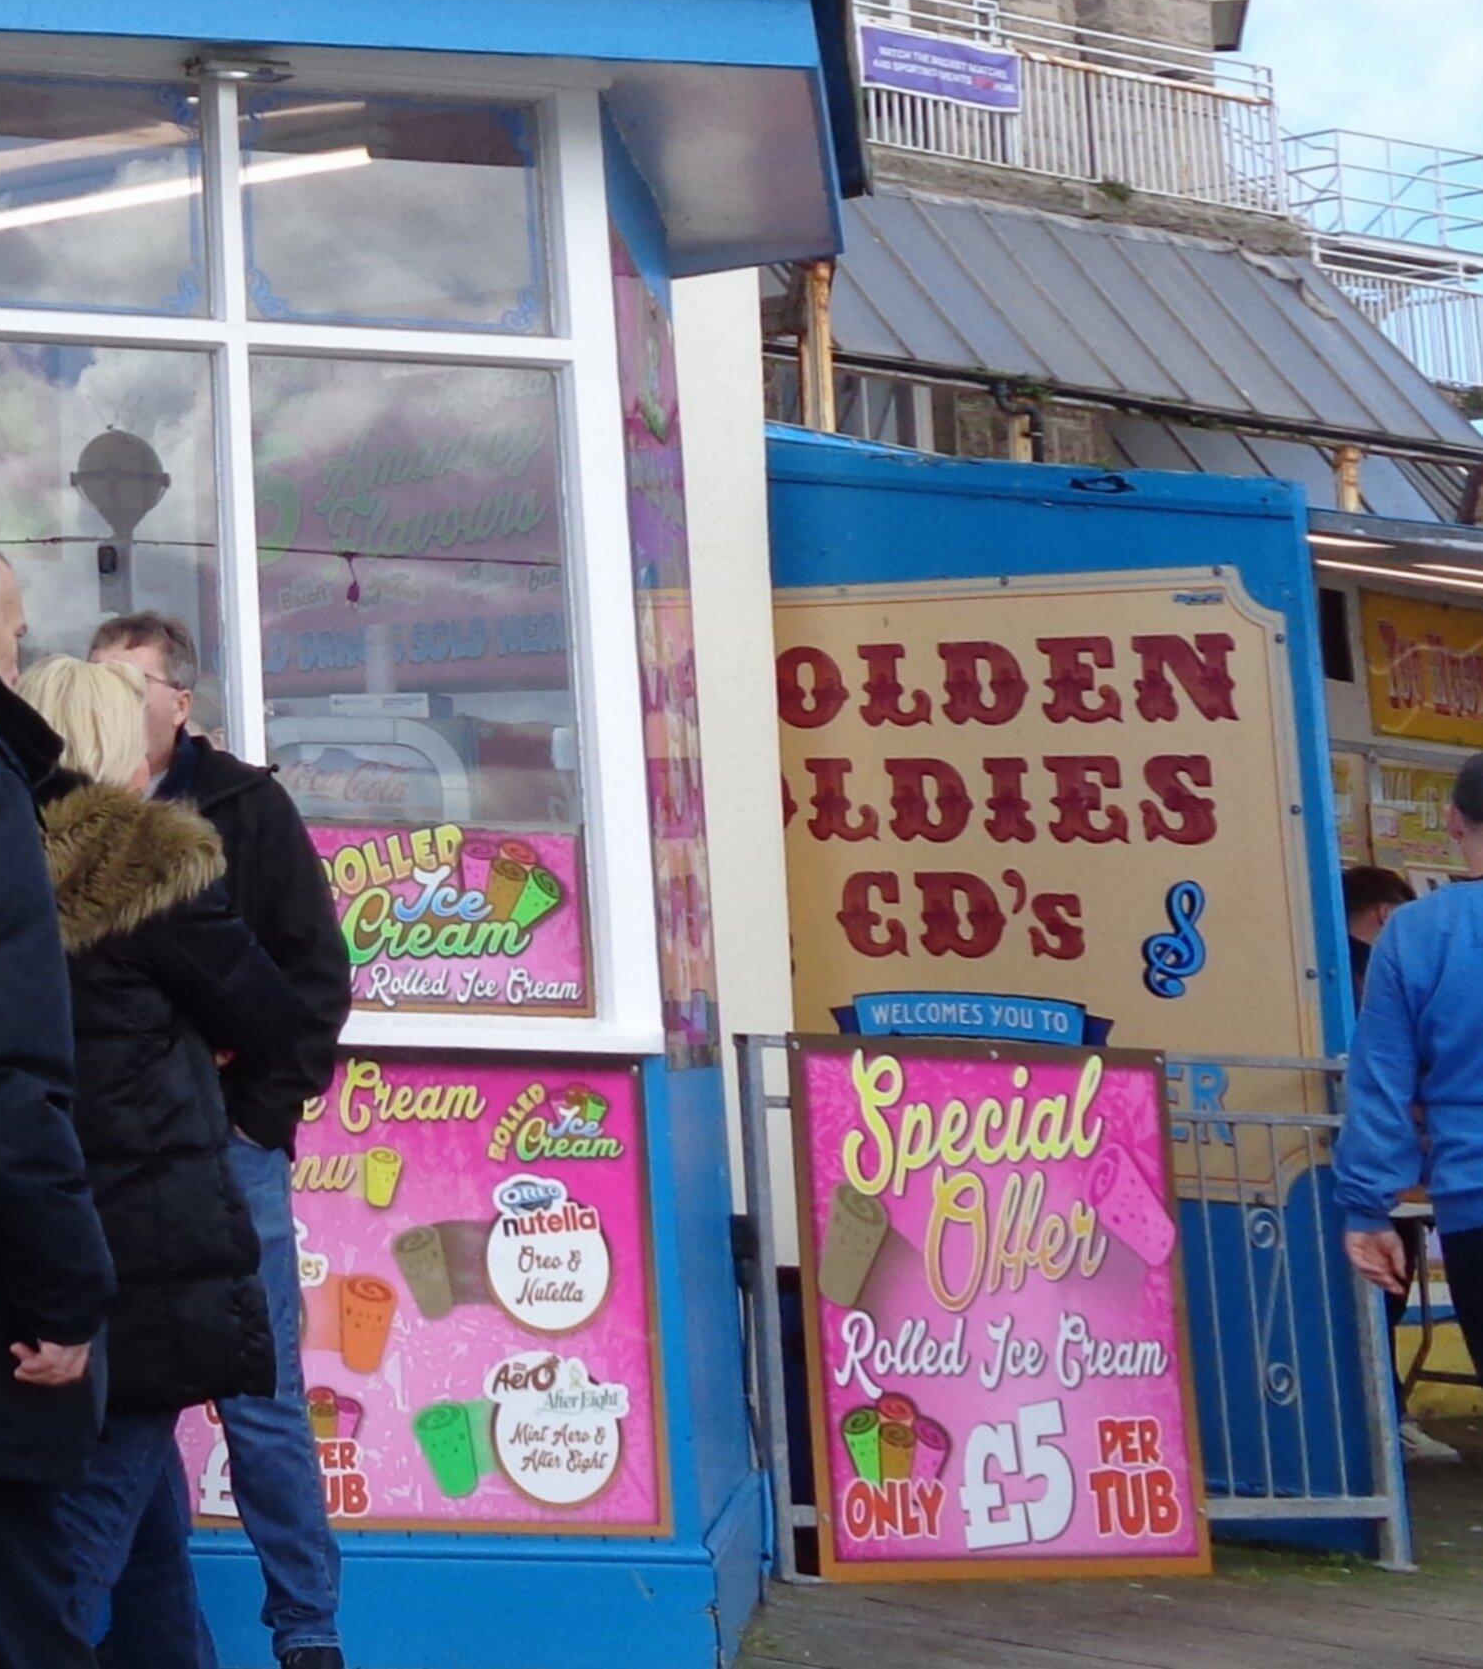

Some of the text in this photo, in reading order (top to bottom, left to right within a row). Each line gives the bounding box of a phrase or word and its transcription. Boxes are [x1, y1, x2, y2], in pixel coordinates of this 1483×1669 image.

[776, 634, 1240, 729] OLDEN
[782, 755, 1217, 845] LDIES
[393, 865, 492, 923] Ice
[341, 888, 530, 965] Cream
[366, 964, 448, 1007] Rolled
[457, 967, 500, 1005] Ice
[506, 967, 582, 1004] Cream
[871, 1001, 1069, 1034] WELCOMES YOU TO
[339, 1058, 486, 1133] Cream
[487, 1082, 546, 1162] ROLLED
[516, 1117, 624, 1161] Cream
[547, 1105, 604, 1138] Ice
[842, 1048, 1104, 1196] Special
[501, 1185, 562, 1208] OREO
[502, 1206, 597, 1237] nutella
[925, 1165, 1107, 1311] Offer
[518, 1245, 581, 1273] Oreo &
[516, 1276, 584, 1307] Nutella
[835, 1310, 1168, 1399] Rolled Ice Cream
[492, 1362, 557, 1394] Aero
[544, 1388, 619, 1411] After Eight
[509, 1422, 606, 1447] Mint Aero &
[1098, 1419, 1161, 1465] PER
[520, 1449, 609, 1474] After Eight
[959, 1399, 1076, 1550] £5
[322, 1473, 369, 1515] UB
[844, 1481, 945, 1538] ONLY
[1090, 1469, 1179, 1536] TUB
